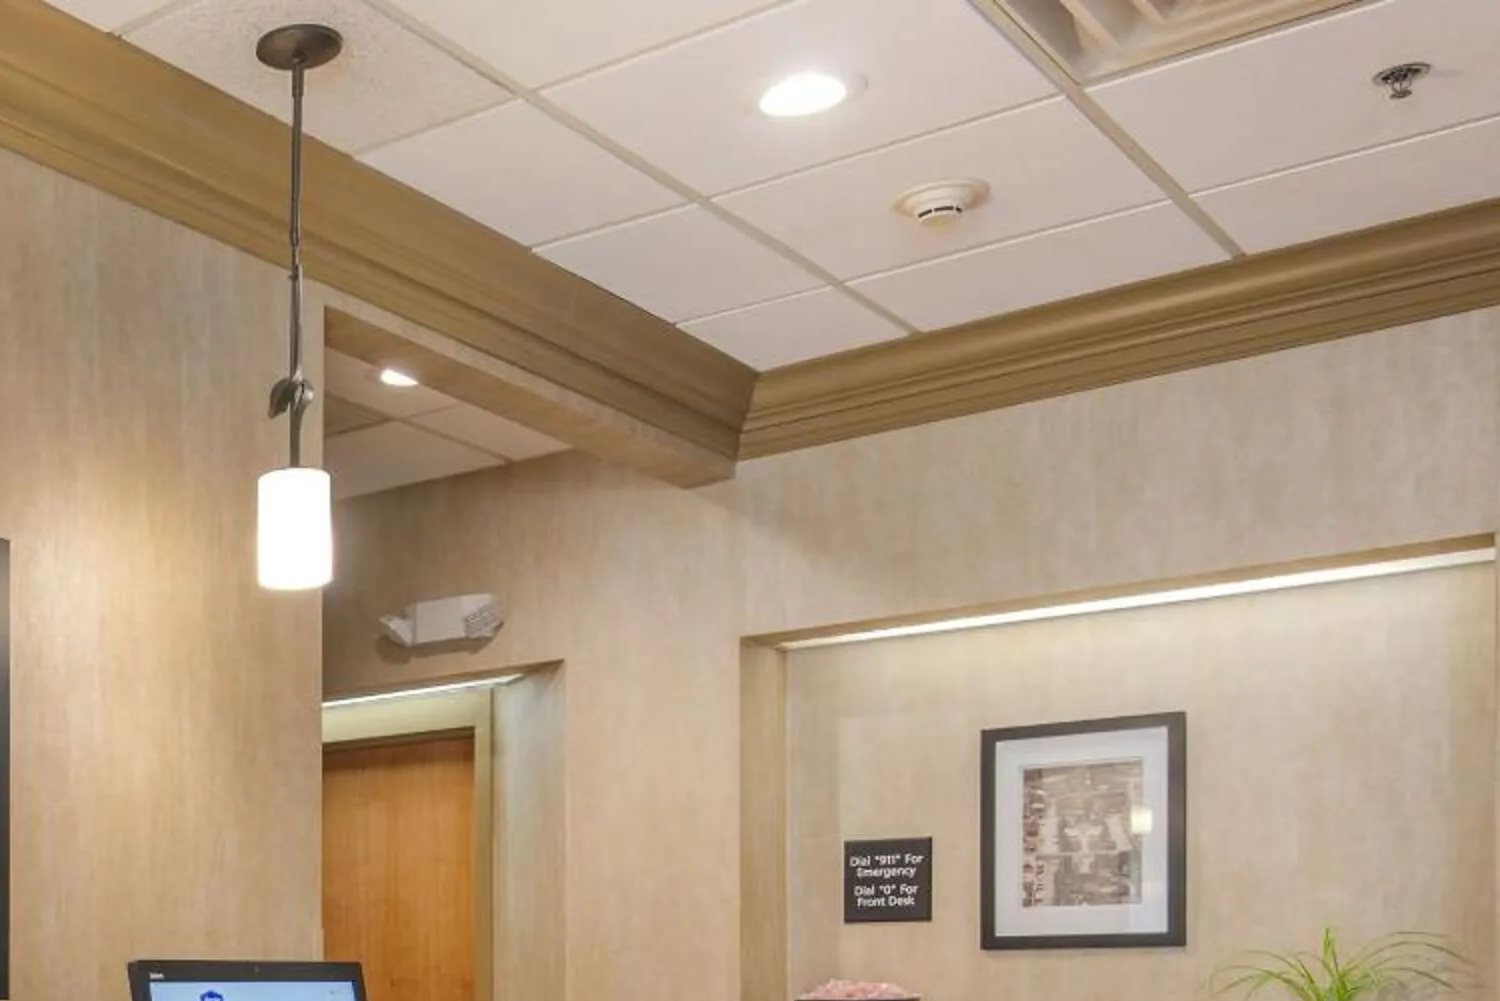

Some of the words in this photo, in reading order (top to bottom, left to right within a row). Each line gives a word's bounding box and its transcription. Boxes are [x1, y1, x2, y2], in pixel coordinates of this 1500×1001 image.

[849, 855, 871, 867] Dial
[905, 853, 924, 865] For
[856, 867, 917, 878] Emergency
[853, 884, 875, 896] Dial
[900, 883, 919, 895] For
[857, 897, 886, 908] Front
[888, 895, 916, 907] Desk
